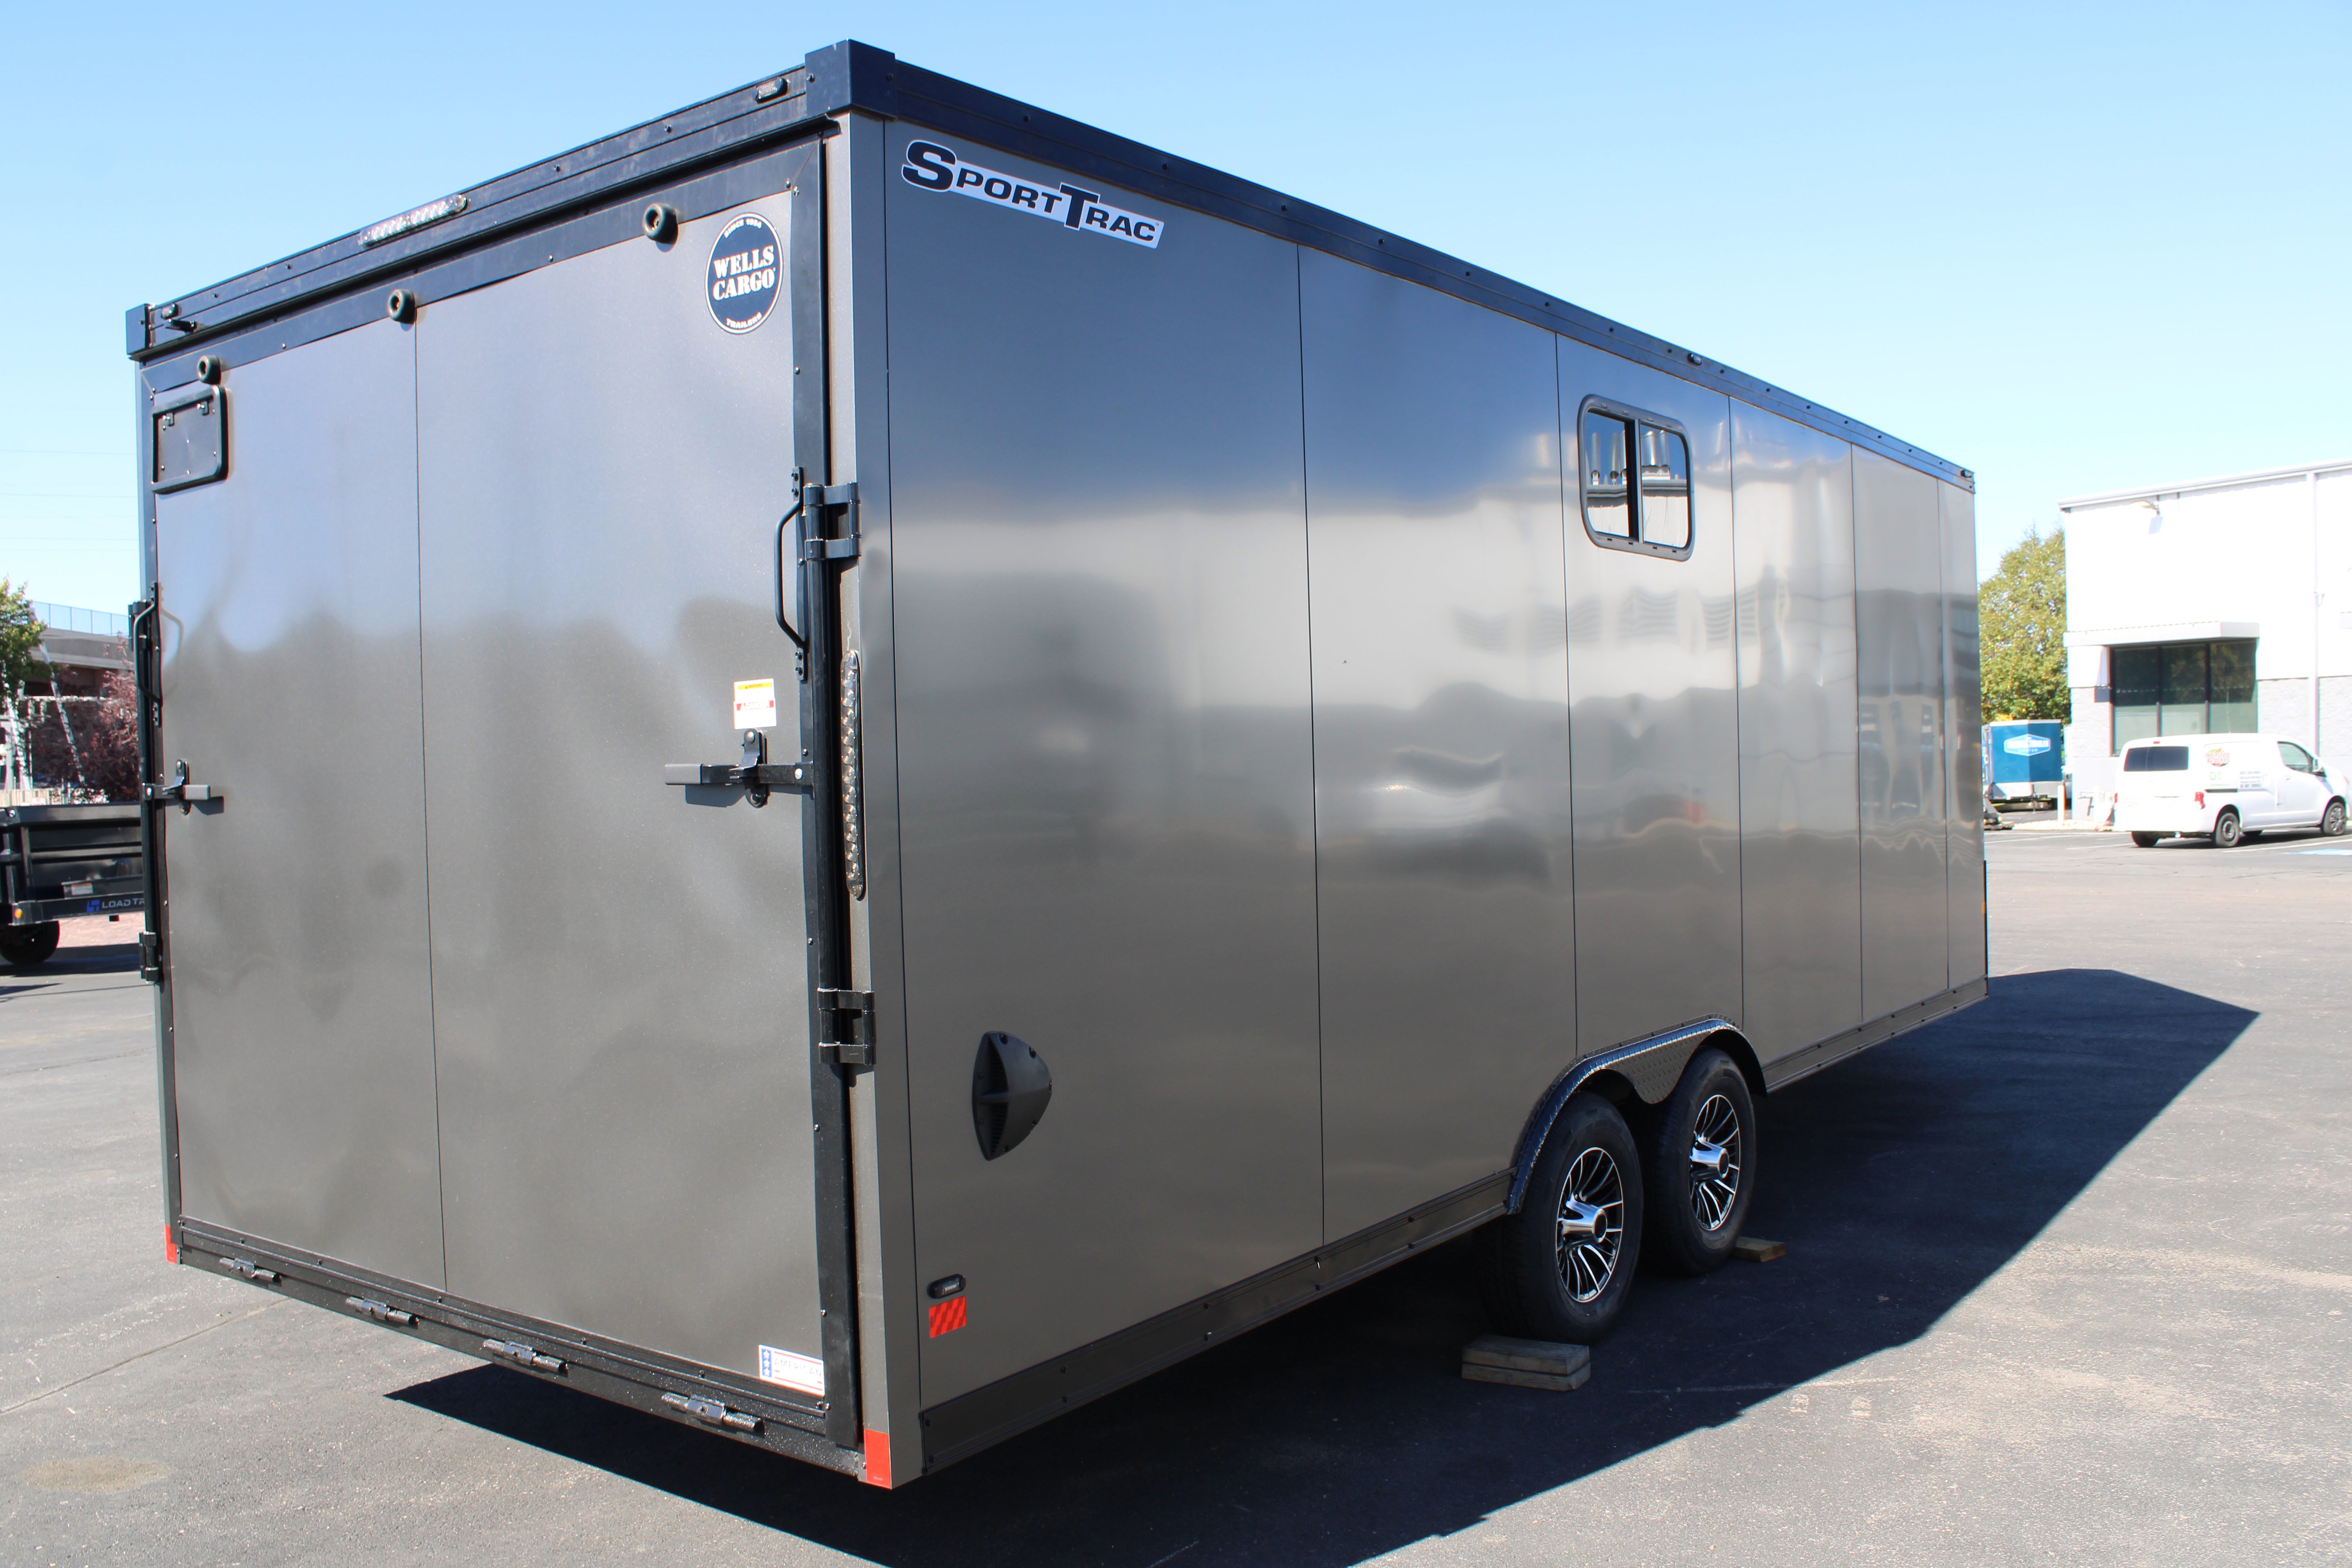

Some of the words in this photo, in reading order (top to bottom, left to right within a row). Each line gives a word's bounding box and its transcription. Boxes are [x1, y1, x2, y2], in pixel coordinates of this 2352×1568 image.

[724, 218, 744, 238] SINCE
[713, 245, 774, 279] WELLS
[713, 268, 775, 301] CARGO
[726, 312, 762, 329] TRAILERS
[102, 899, 131, 909] LOAD
[774, 1358, 821, 1377] AMERICAN
